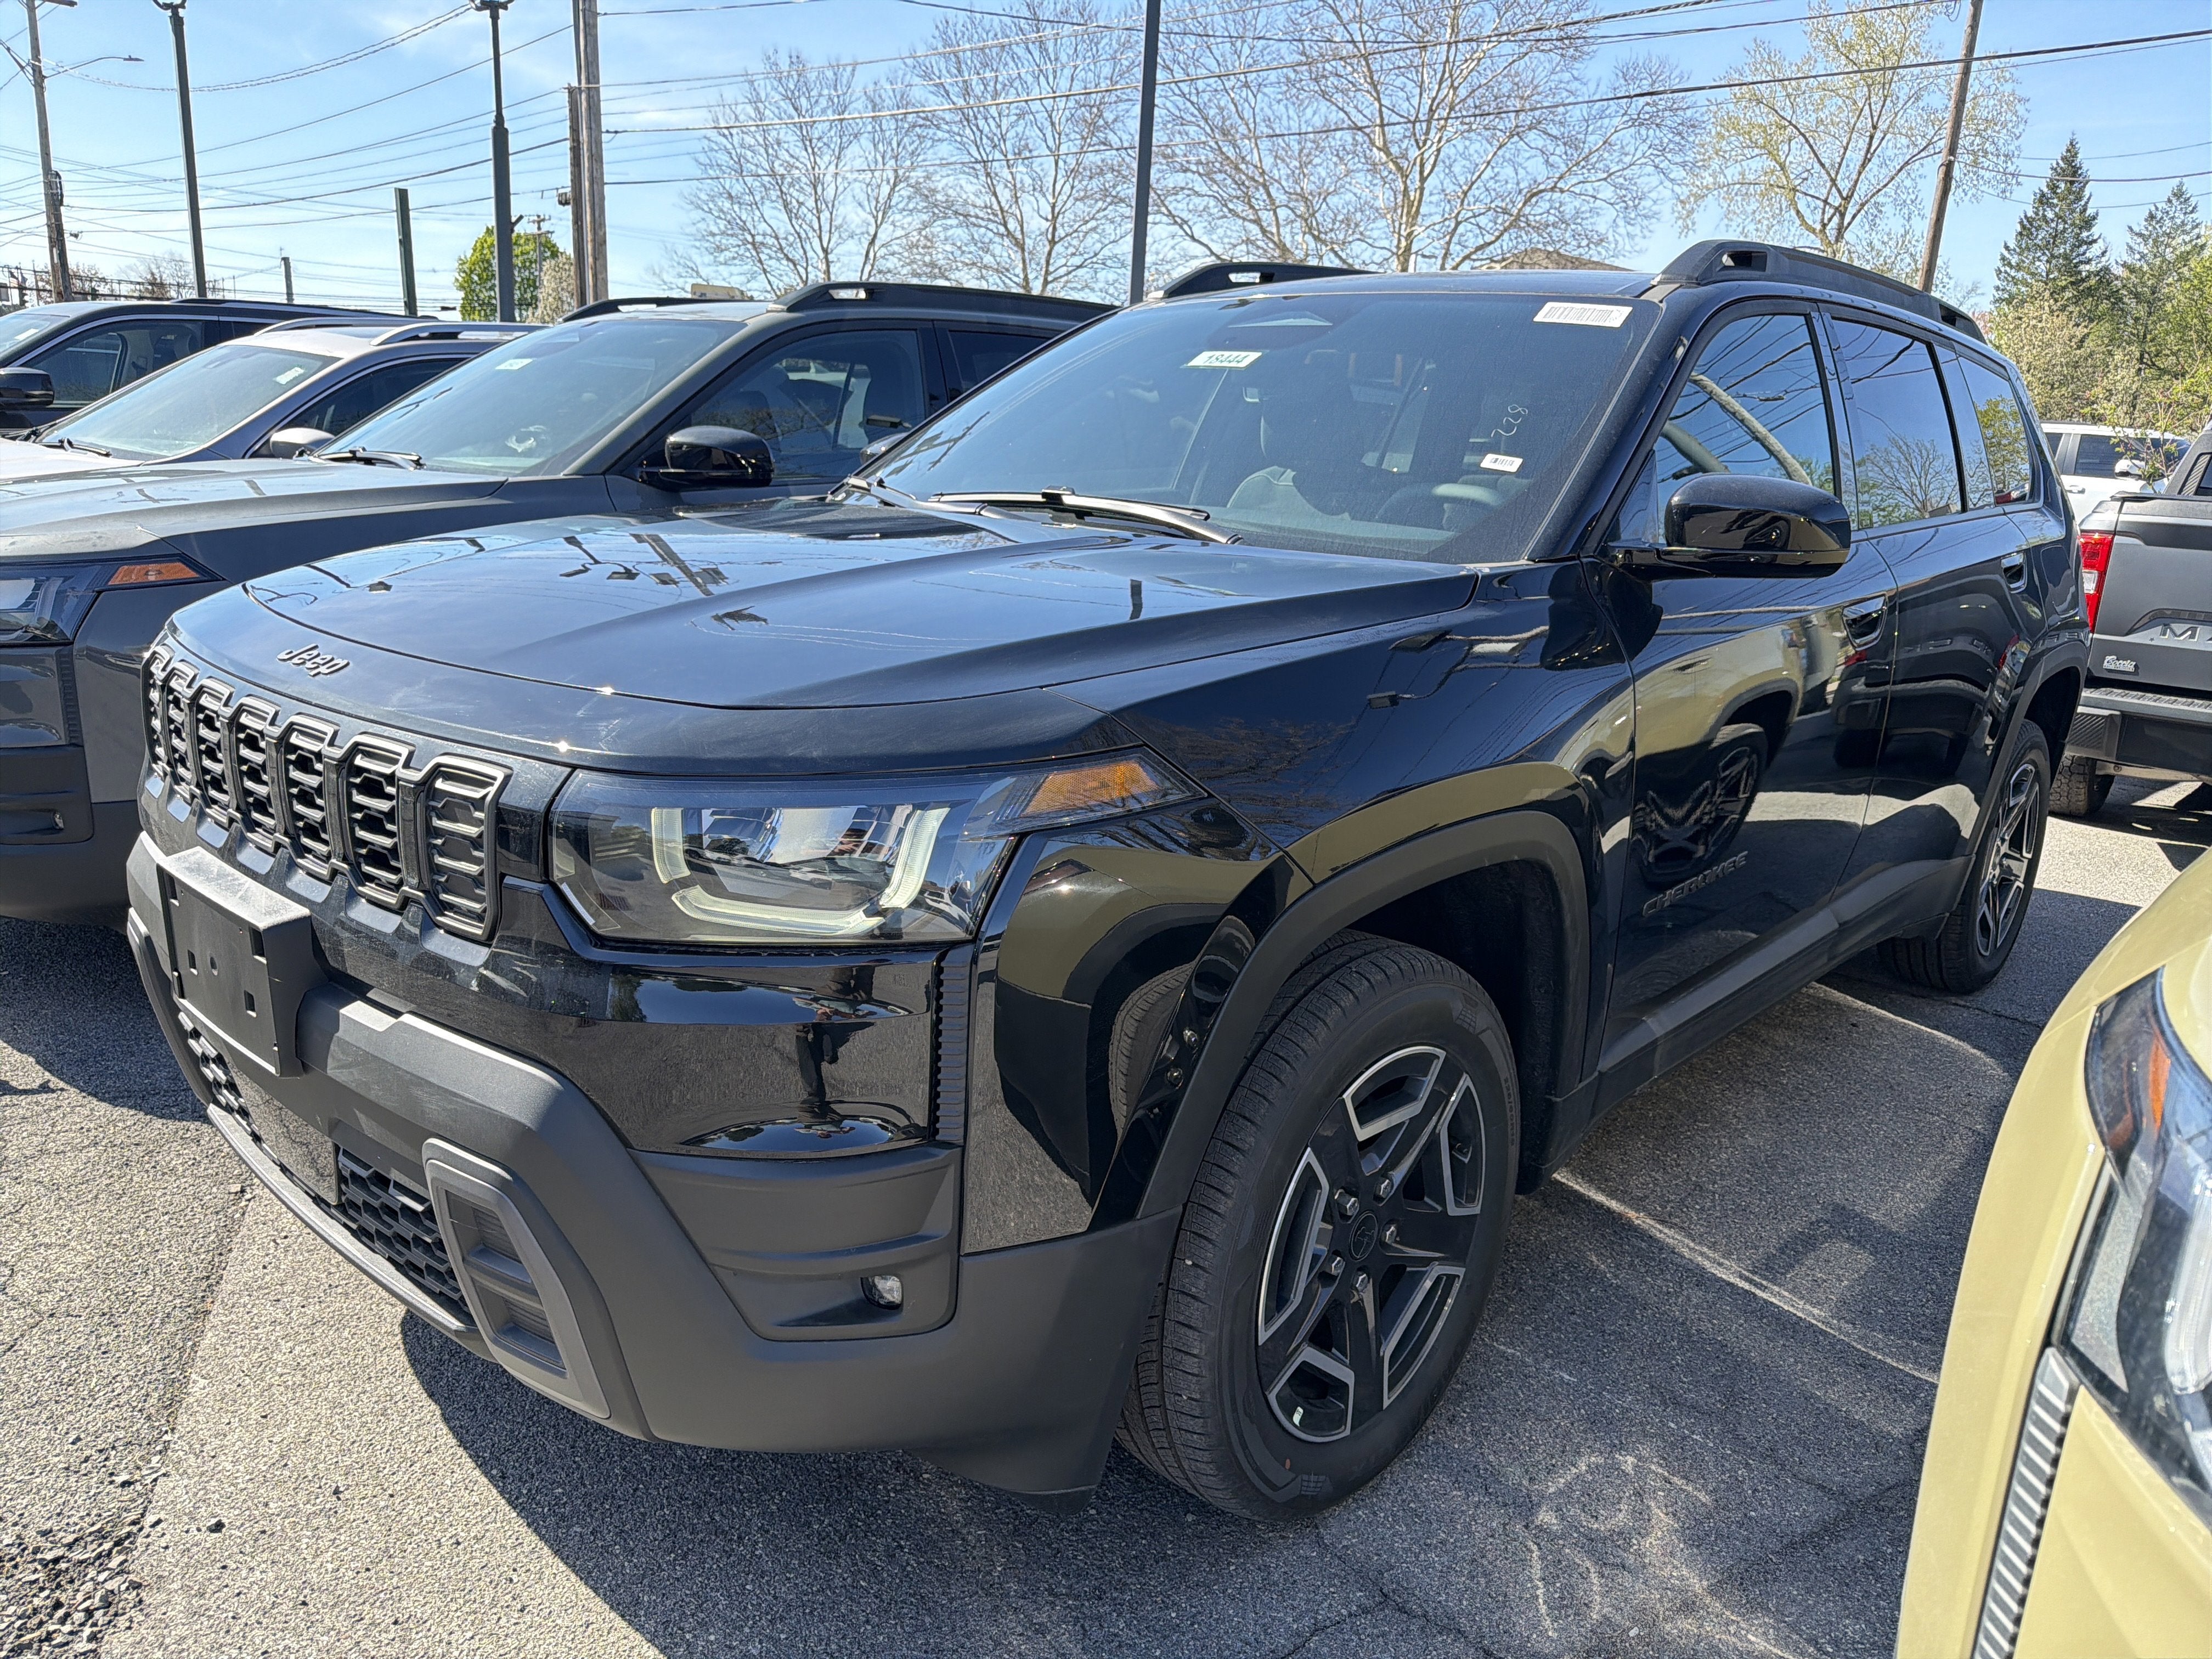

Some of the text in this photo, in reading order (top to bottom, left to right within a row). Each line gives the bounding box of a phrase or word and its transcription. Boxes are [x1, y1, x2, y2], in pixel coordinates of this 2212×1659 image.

[1491, 404, 1528, 438] 228
[2159, 624, 2212, 644] M
[276, 644, 351, 678] Jeep
[1642, 850, 1748, 917] CHEROKEE
